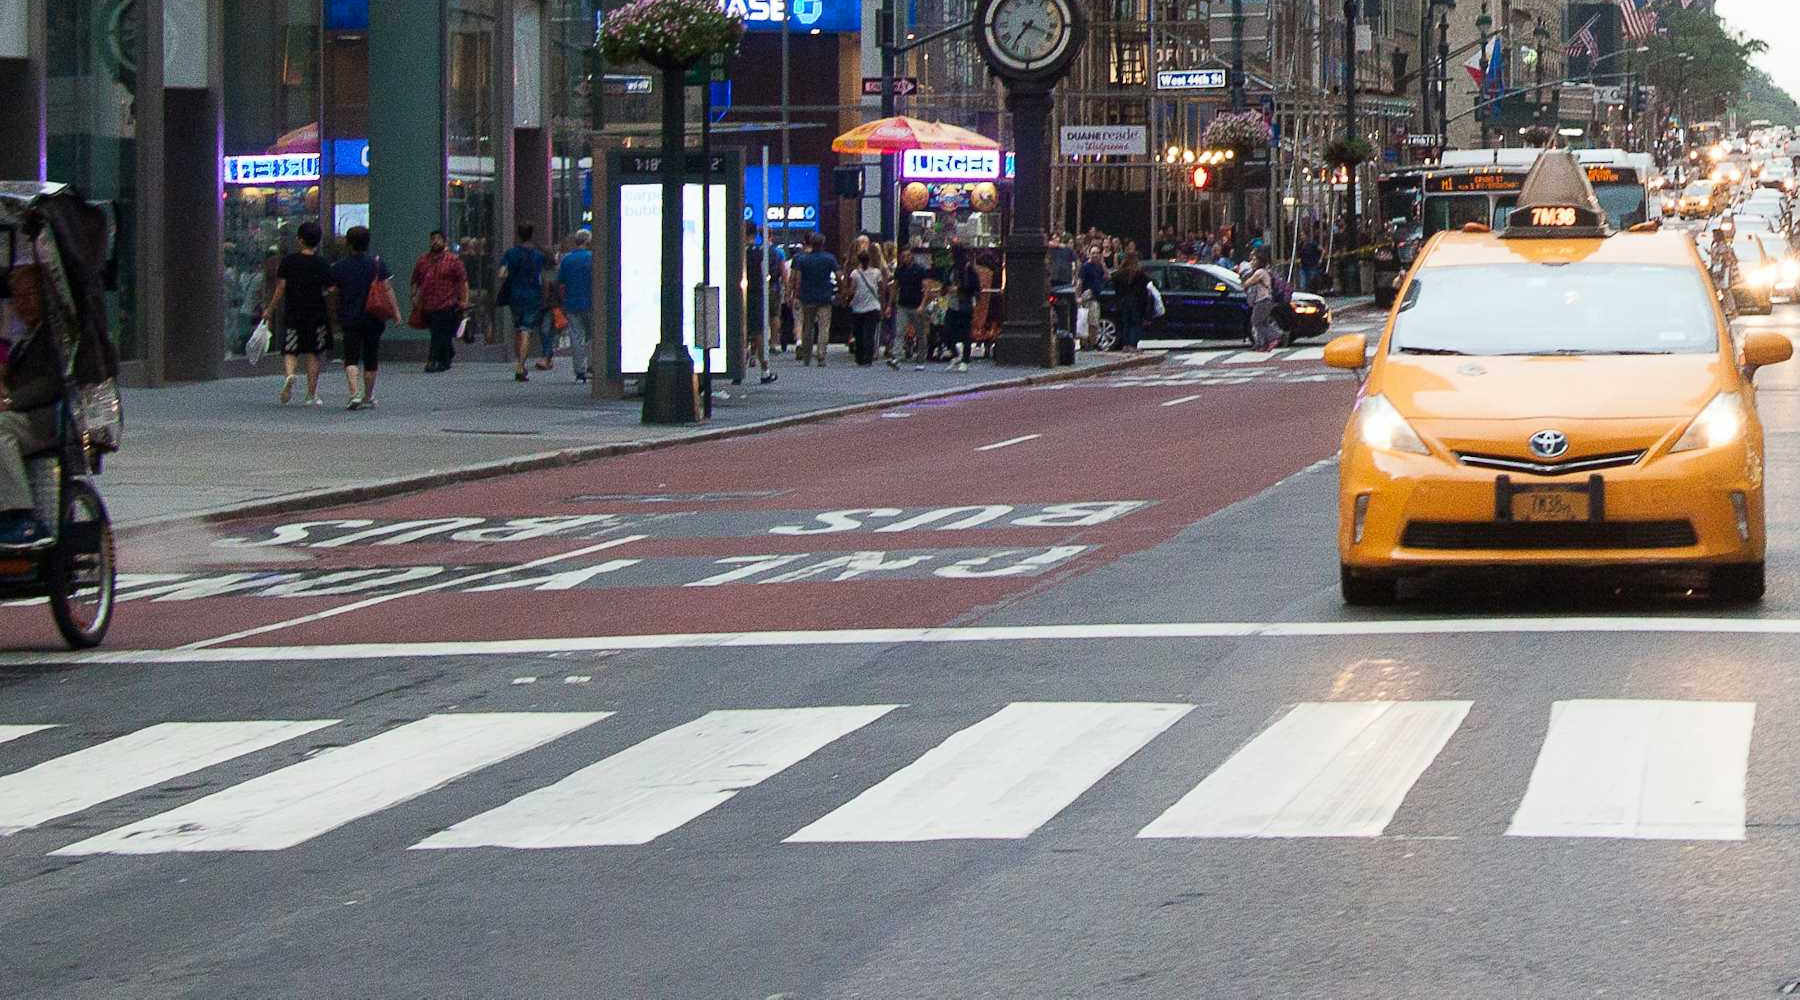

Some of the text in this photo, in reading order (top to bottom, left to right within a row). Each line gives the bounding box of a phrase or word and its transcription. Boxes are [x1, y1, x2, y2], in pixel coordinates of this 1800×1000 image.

[1160, 72, 1223, 87] West 44th St
[214, 513, 616, 549] BUS
[768, 500, 1147, 536] BUS
